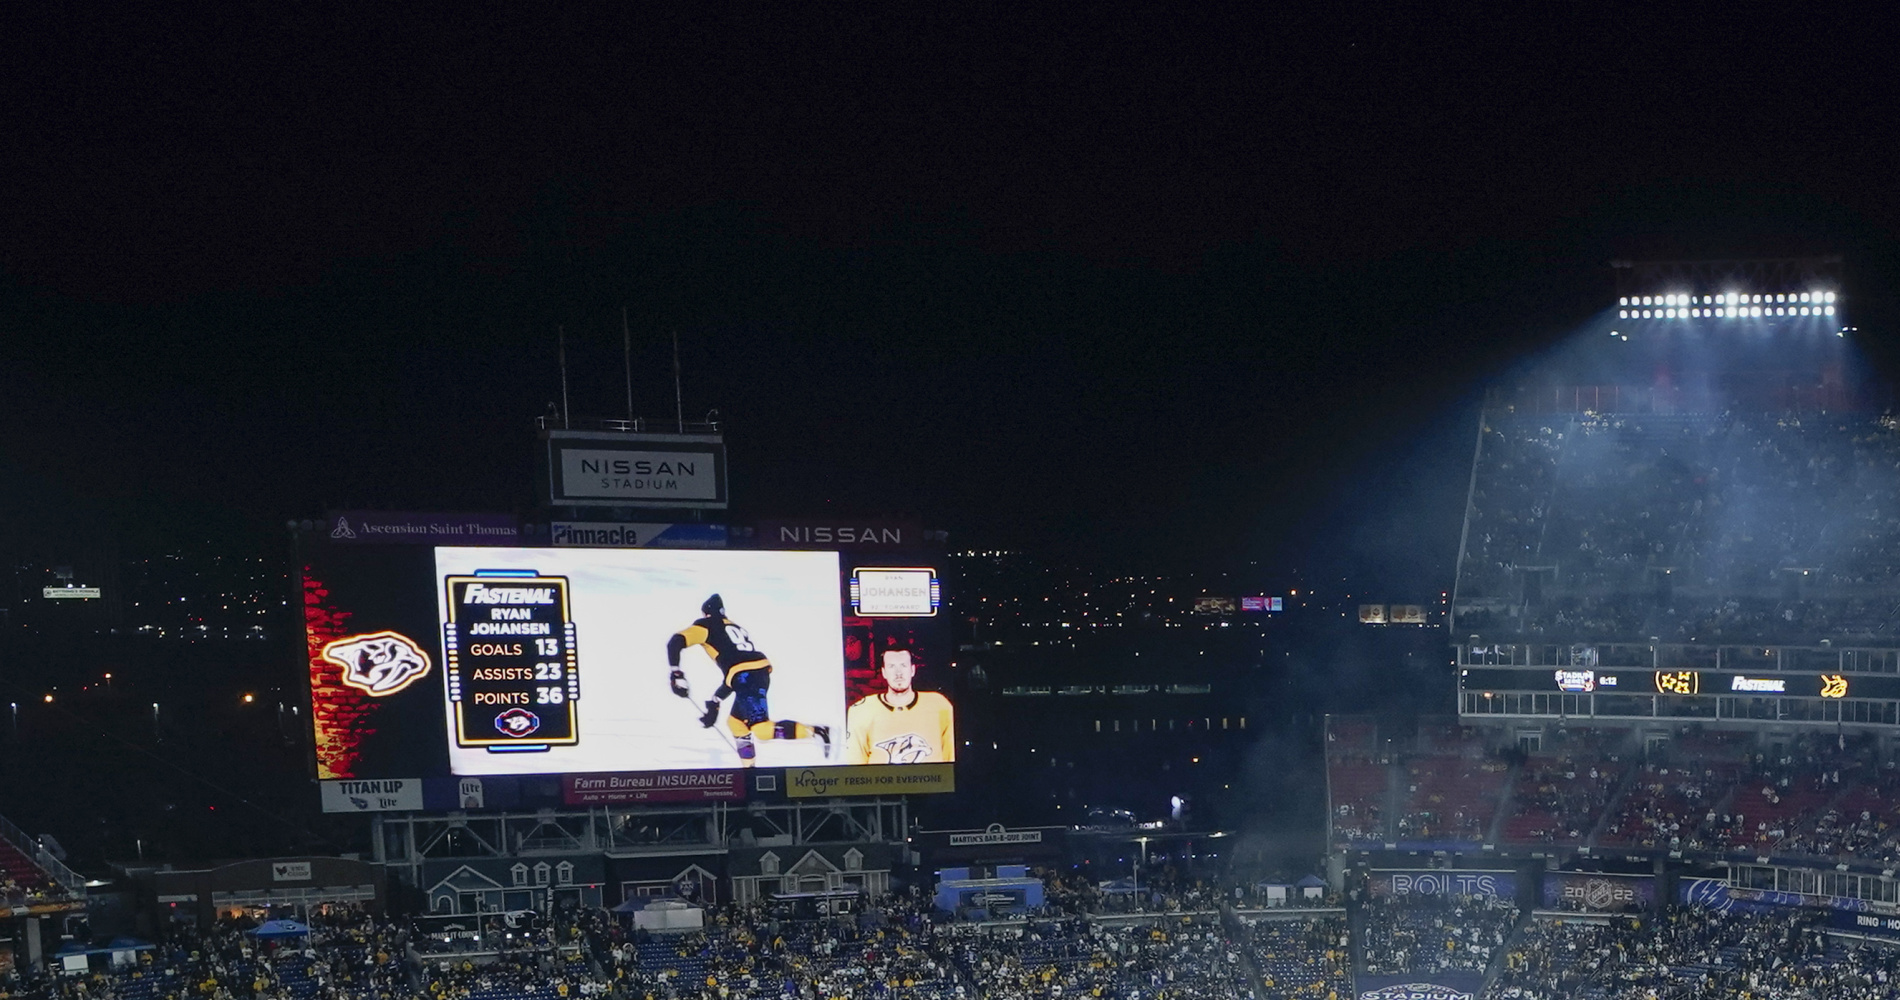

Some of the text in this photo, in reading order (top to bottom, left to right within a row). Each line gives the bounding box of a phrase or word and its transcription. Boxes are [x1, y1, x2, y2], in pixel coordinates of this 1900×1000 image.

[582, 459, 695, 476] NISSAN
[601, 478, 678, 490] STADIUM
[360, 522, 517, 536] Ascension Saint Thomas
[553, 524, 637, 545] Pinnacle
[780, 525, 901, 544] NISSAN
[464, 583, 554, 604] FASTENAL
[862, 587, 927, 597] JOHANSEN
[491, 608, 531, 620] RYAN
[470, 622, 550, 635] JOHANSEN
[470, 638, 558, 656] GOALS 13
[473, 662, 562, 680] ASSISTS 23
[1732, 676, 1785, 692] FASTENAL
[474, 687, 563, 705] POINTS 36
[339, 780, 404, 795] TITAN UP
[574, 773, 733, 788] Farm Bureau INSURANCE
[795, 770, 942, 794] Kroger FRESH FOR EVERYONE
[462, 783, 481, 795] Lite
[952, 835, 983, 844] MARTIN'S
[1021, 833, 1039, 841] JOINT
[1392, 874, 1497, 896] BOLTS
[1564, 887, 1584, 898] 20
[1613, 889, 1634, 900] 22
[1857, 915, 1880, 927] RING
